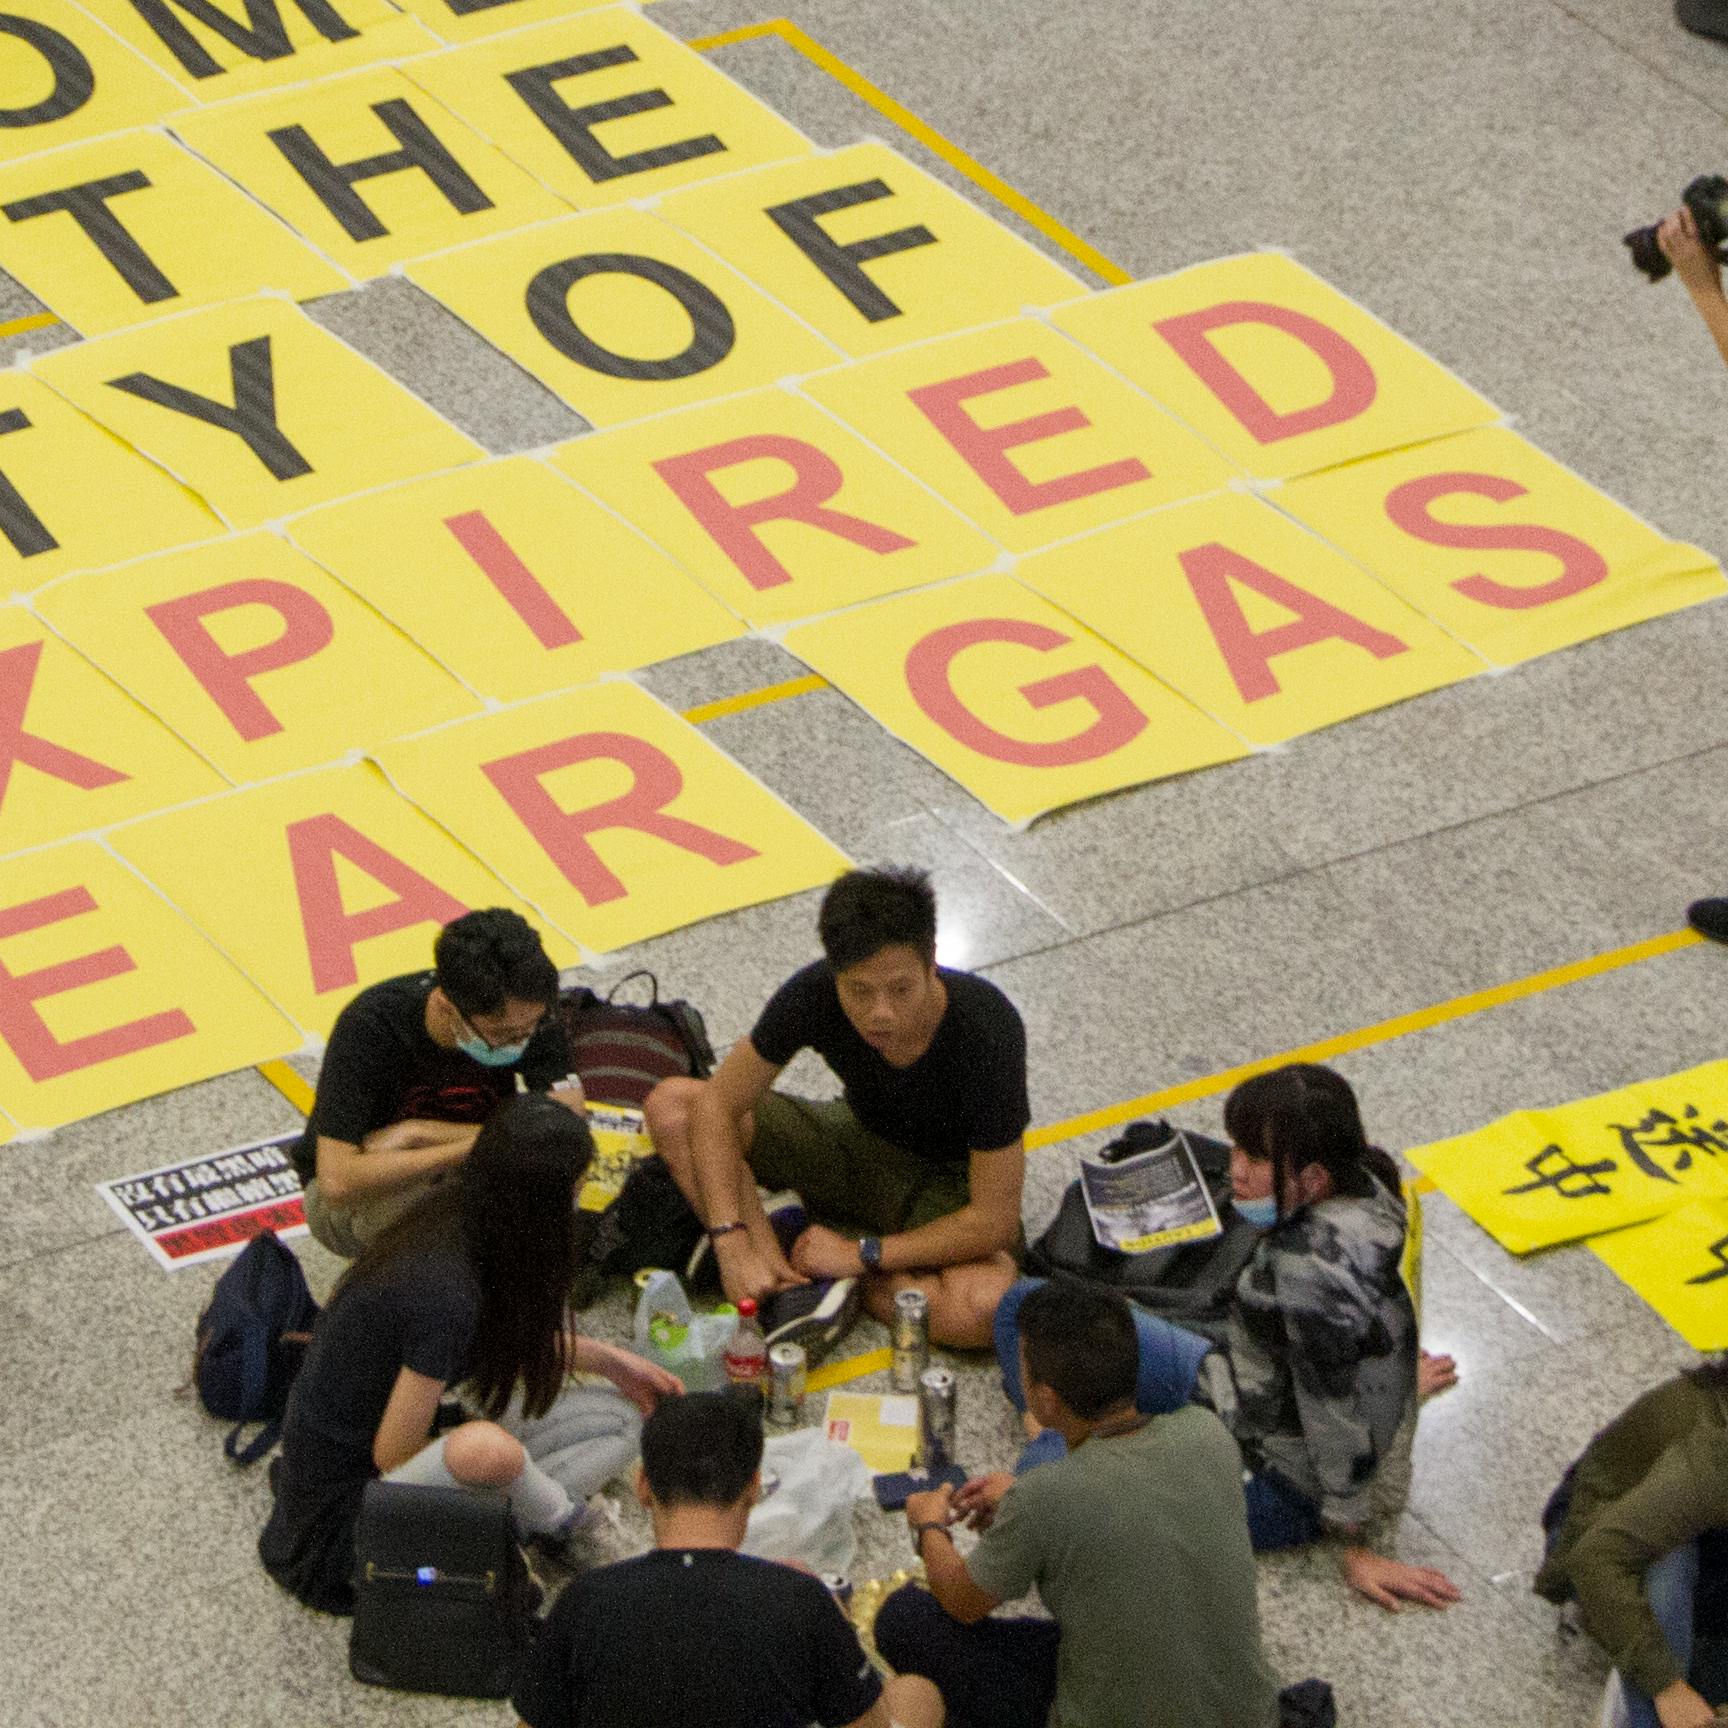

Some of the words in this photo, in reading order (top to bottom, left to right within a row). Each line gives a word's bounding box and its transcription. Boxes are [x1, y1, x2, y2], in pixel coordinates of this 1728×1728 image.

[0, 44, 729, 304] THE
[524, 178, 939, 382] OF
[903, 472, 1610, 768] GAS
